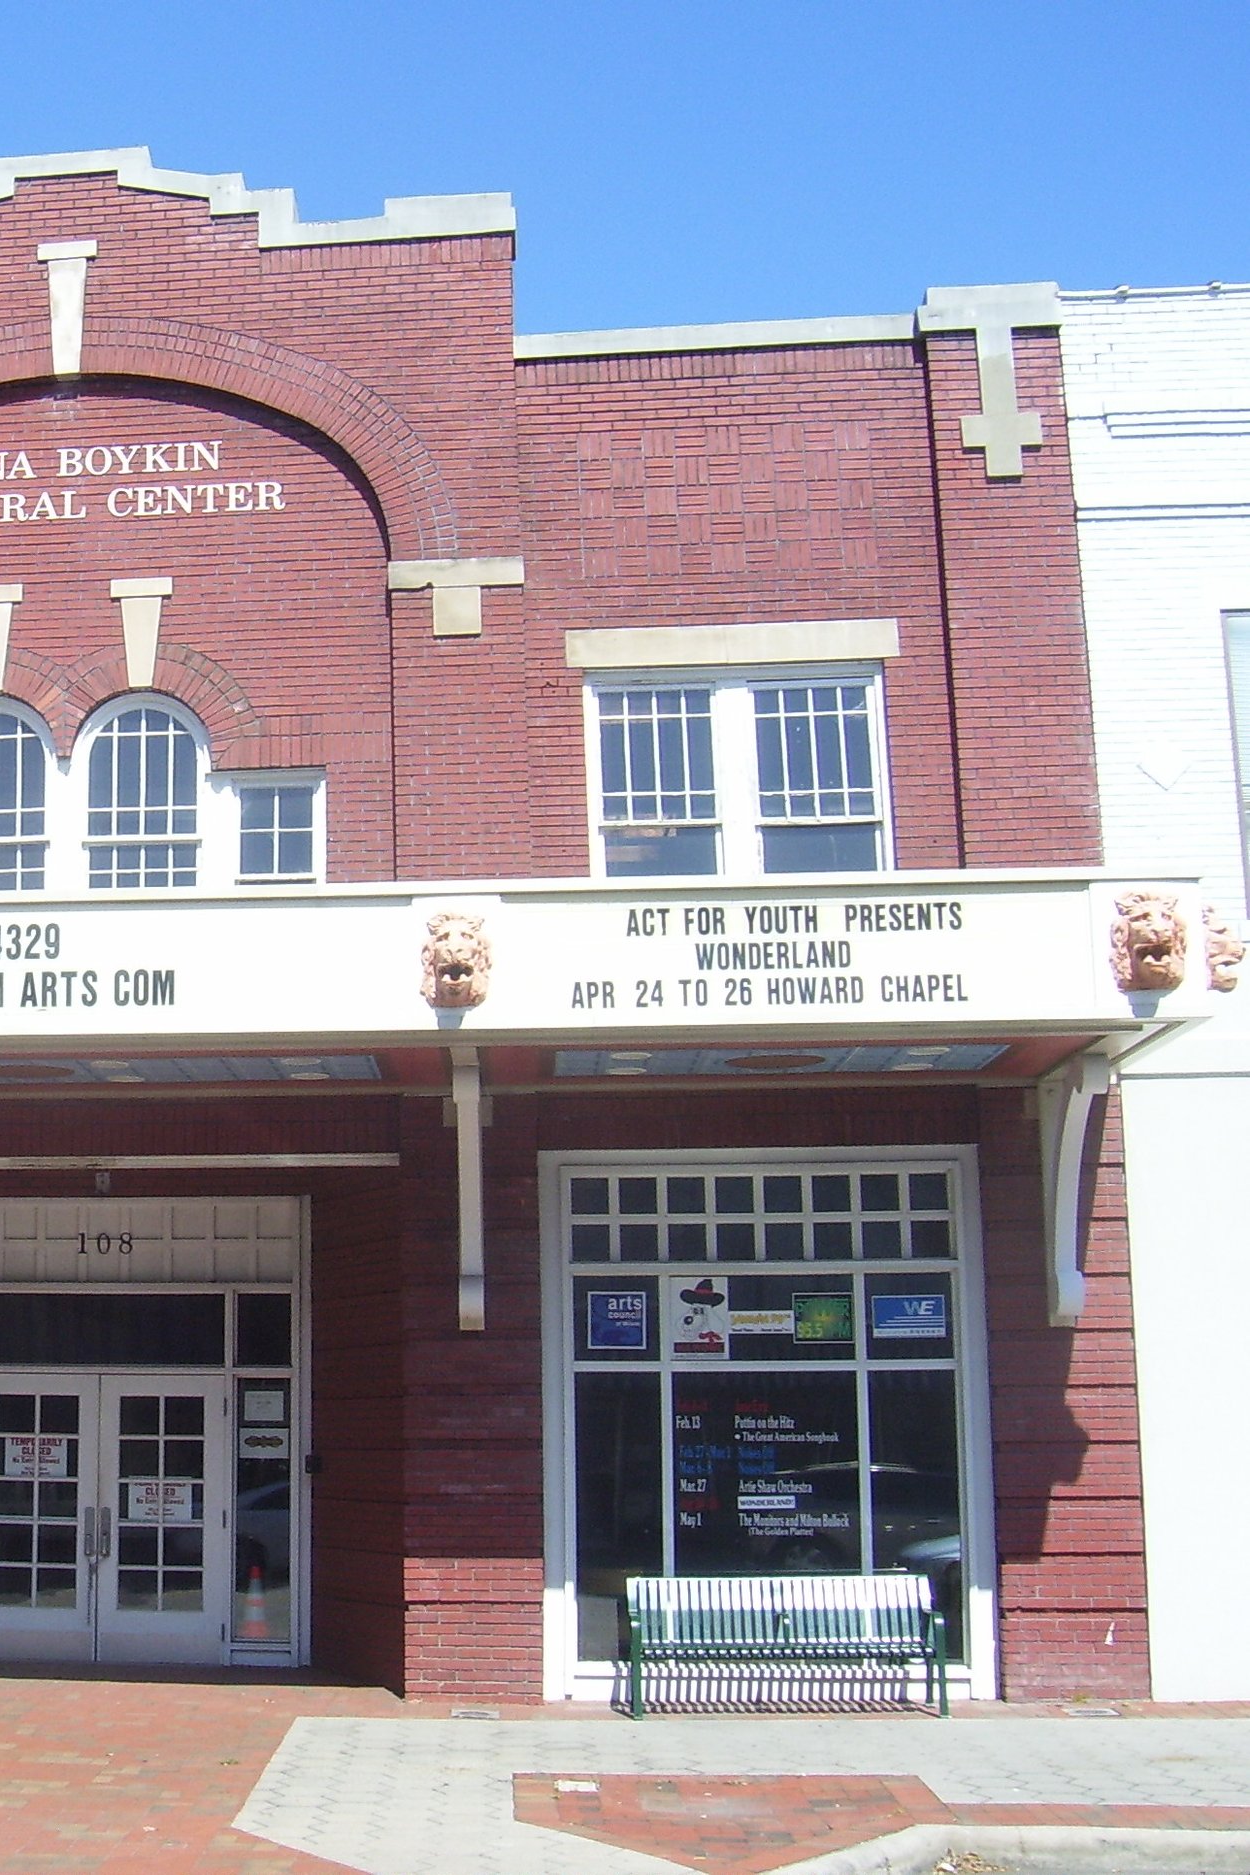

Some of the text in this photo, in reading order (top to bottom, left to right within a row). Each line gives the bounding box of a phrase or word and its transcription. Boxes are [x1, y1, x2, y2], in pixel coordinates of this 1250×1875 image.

[56, 441, 223, 478] BOYKIN
[107, 480, 286, 518] CENTER
[626, 902, 962, 936] ACT FOR YOUTH PRESENTS
[695, 940, 851, 970] WONDERLAND
[20, 970, 98, 1008] ARTS
[114, 969, 175, 1007] COM
[571, 974, 968, 1009] APR 24 TO 26 HOWARD CHAPEL
[77, 1232, 133, 1255] 108
[608, 1296, 642, 1311] arts
[903, 1300, 935, 1315] WE
[608, 1311, 641, 1319] council
[796, 1321, 823, 1338] 95.5
[767, 1415, 779, 1429] the
[742, 1431, 839, 1444] The Great American Songbook
[696, 1478, 707, 1493] 27
[777, 1479, 812, 1494] Orchestra
[679, 1511, 696, 1529] May
[784, 1513, 799, 1527] and
